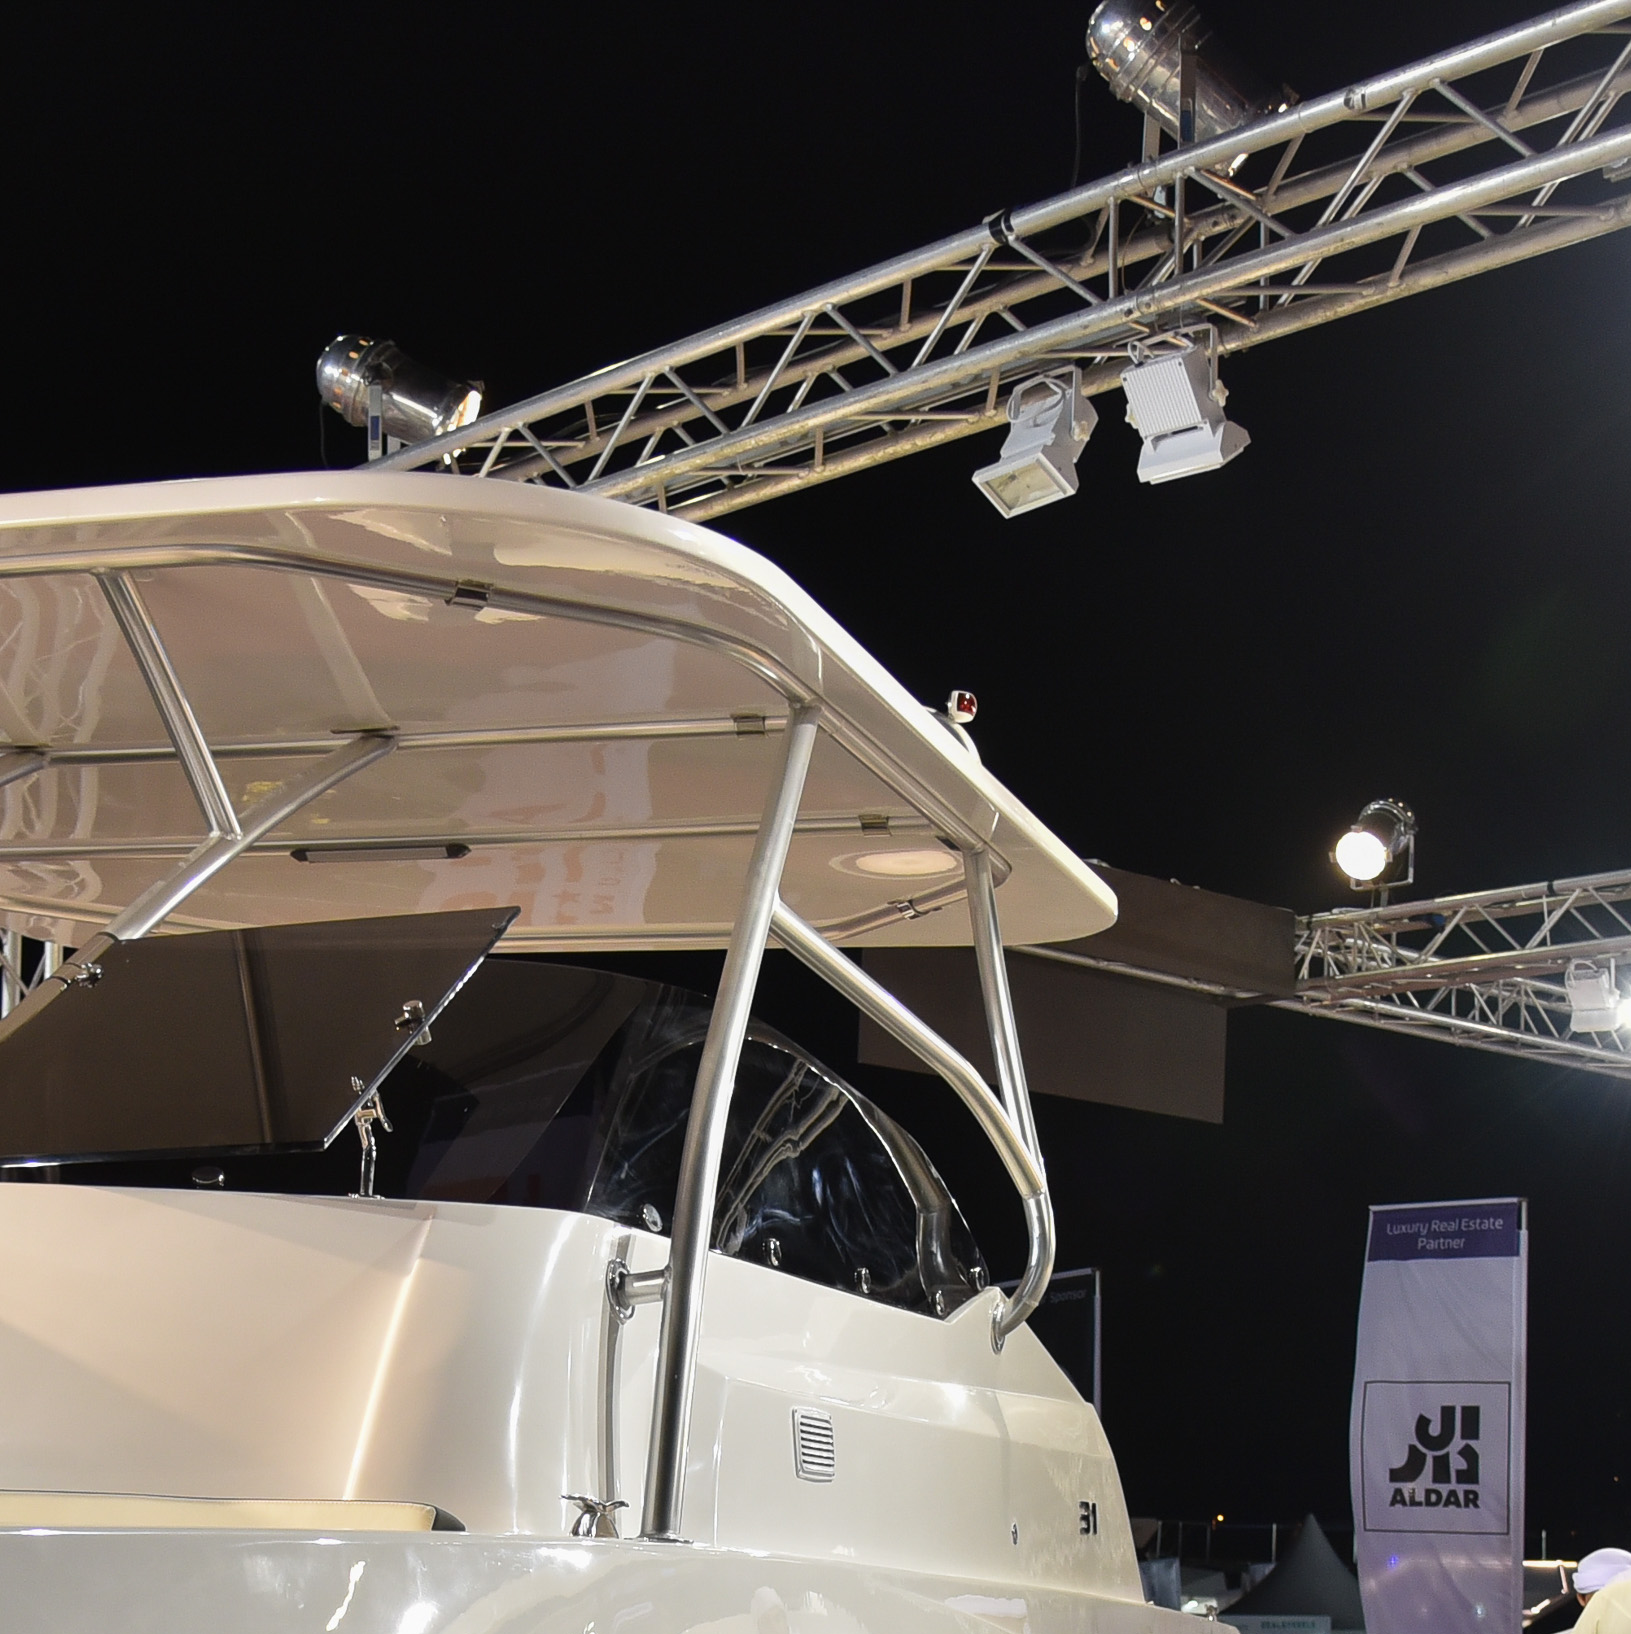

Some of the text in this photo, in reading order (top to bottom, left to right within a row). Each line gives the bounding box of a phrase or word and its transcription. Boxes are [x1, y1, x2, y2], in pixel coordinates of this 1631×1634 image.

[1386, 1217, 1504, 1235] Luxury Real Estate
[1417, 1237, 1466, 1250] Partner
[1389, 1487, 1480, 1508] ALDAR
[1079, 1501, 1097, 1535] 31
